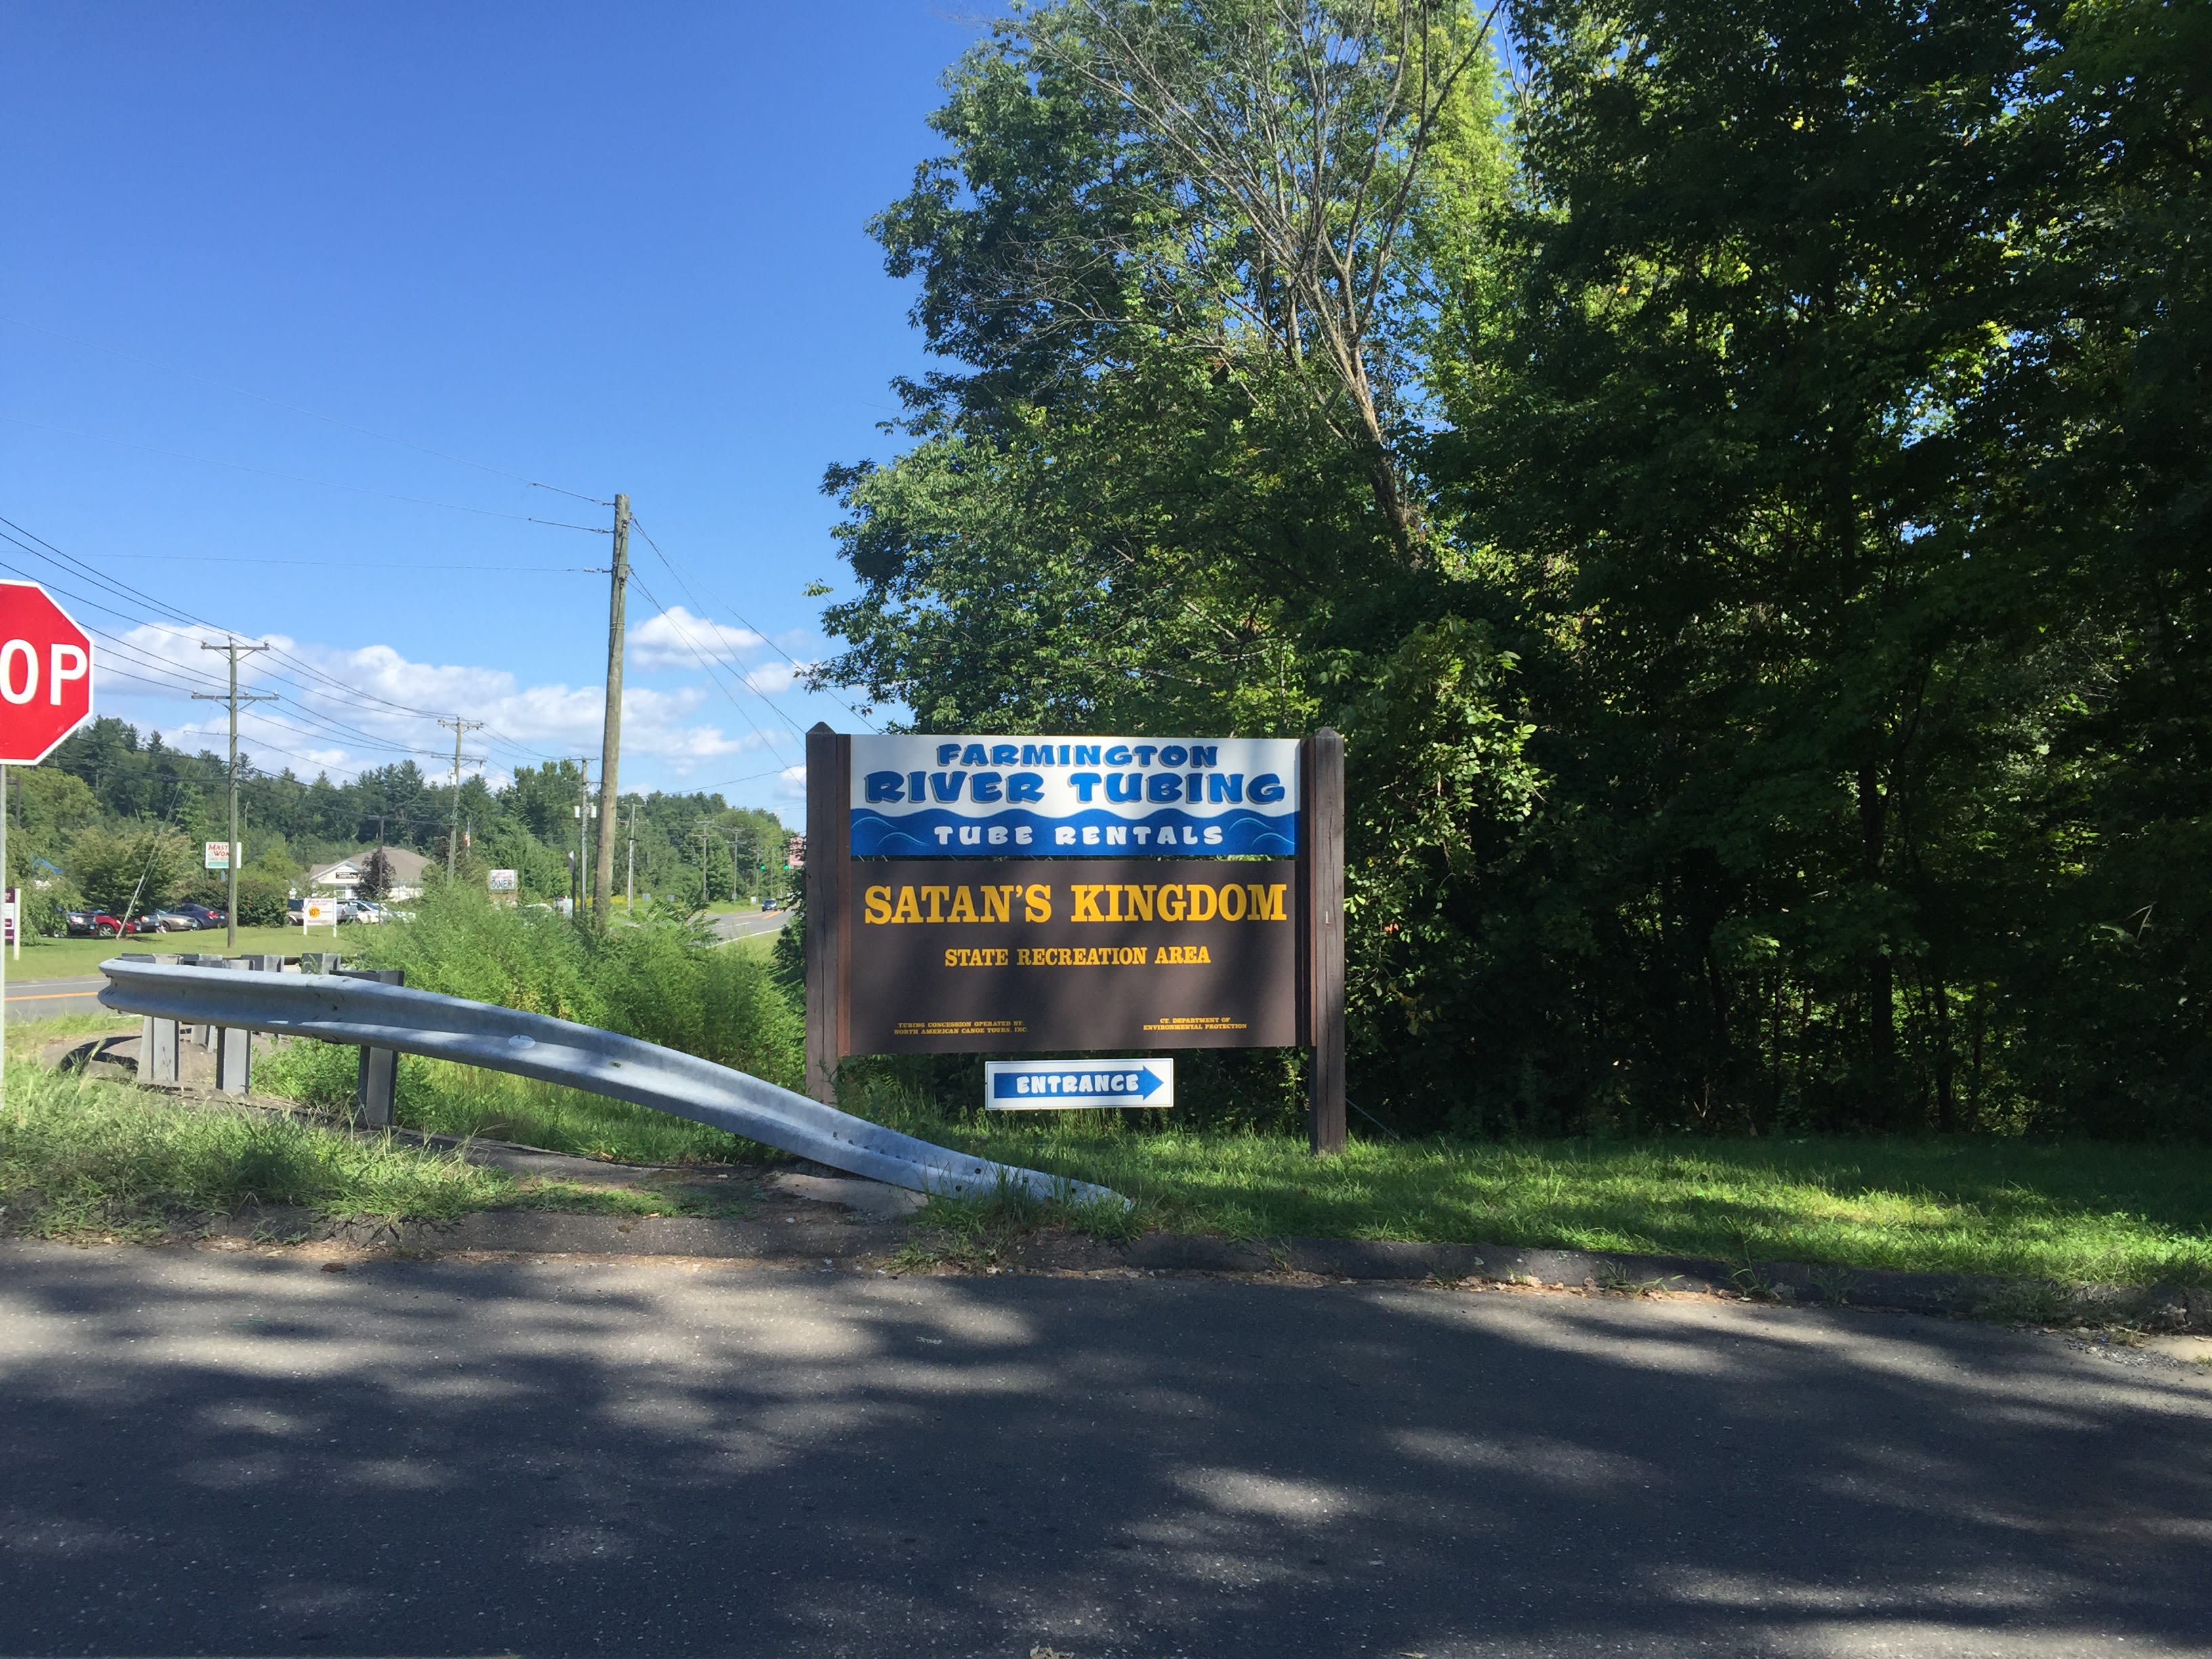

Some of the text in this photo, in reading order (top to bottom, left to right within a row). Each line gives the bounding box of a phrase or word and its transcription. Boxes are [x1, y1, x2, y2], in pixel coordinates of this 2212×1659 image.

[936, 743, 1218, 768] FARMINGTON
[863, 771, 1285, 805] RIVER TUBING
[934, 825, 1223, 845] TUBE RENTALS
[865, 884, 1287, 924] SATAN'S KINGDOM
[945, 946, 1211, 966] STATE RECREATION AREA
[1017, 1074, 1139, 1094] ENTRANCE
